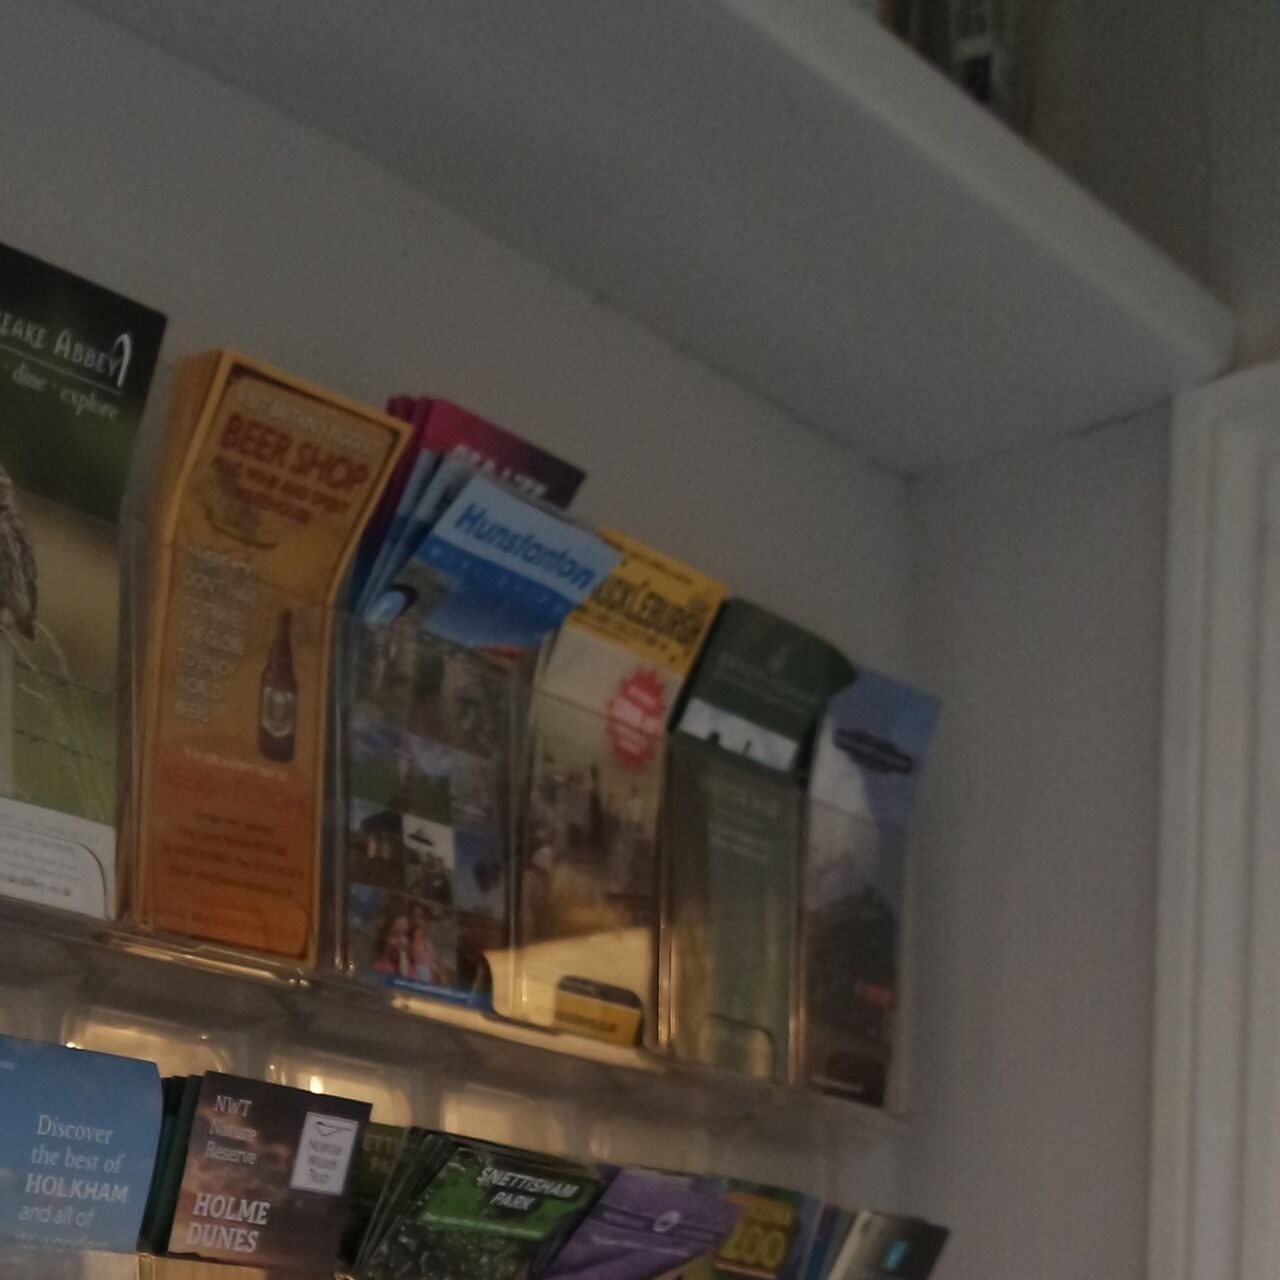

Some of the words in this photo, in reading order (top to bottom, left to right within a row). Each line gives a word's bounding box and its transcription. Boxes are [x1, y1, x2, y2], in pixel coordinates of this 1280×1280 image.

[221, 413, 292, 467] BEER
[290, 440, 369, 492] SHOP
[454, 502, 596, 591] Hunstanton
[214, 1094, 252, 1118] NWT
[35, 1113, 115, 1145] Discover
[30, 1142, 61, 1167] the
[64, 1147, 99, 1172] best
[102, 1152, 125, 1174] of
[205, 1140, 258, 1165] Reserve
[23, 1172, 129, 1204] HOLKHAM
[479, 1167, 579, 1198] SNETTISHAM
[18, 1203, 51, 1225] and
[53, 1205, 72, 1225] all
[75, 1208, 96, 1227] of
[192, 1192, 270, 1226] HOLME
[489, 1190, 537, 1211] PARK
[185, 1222, 260, 1253] DUNES
